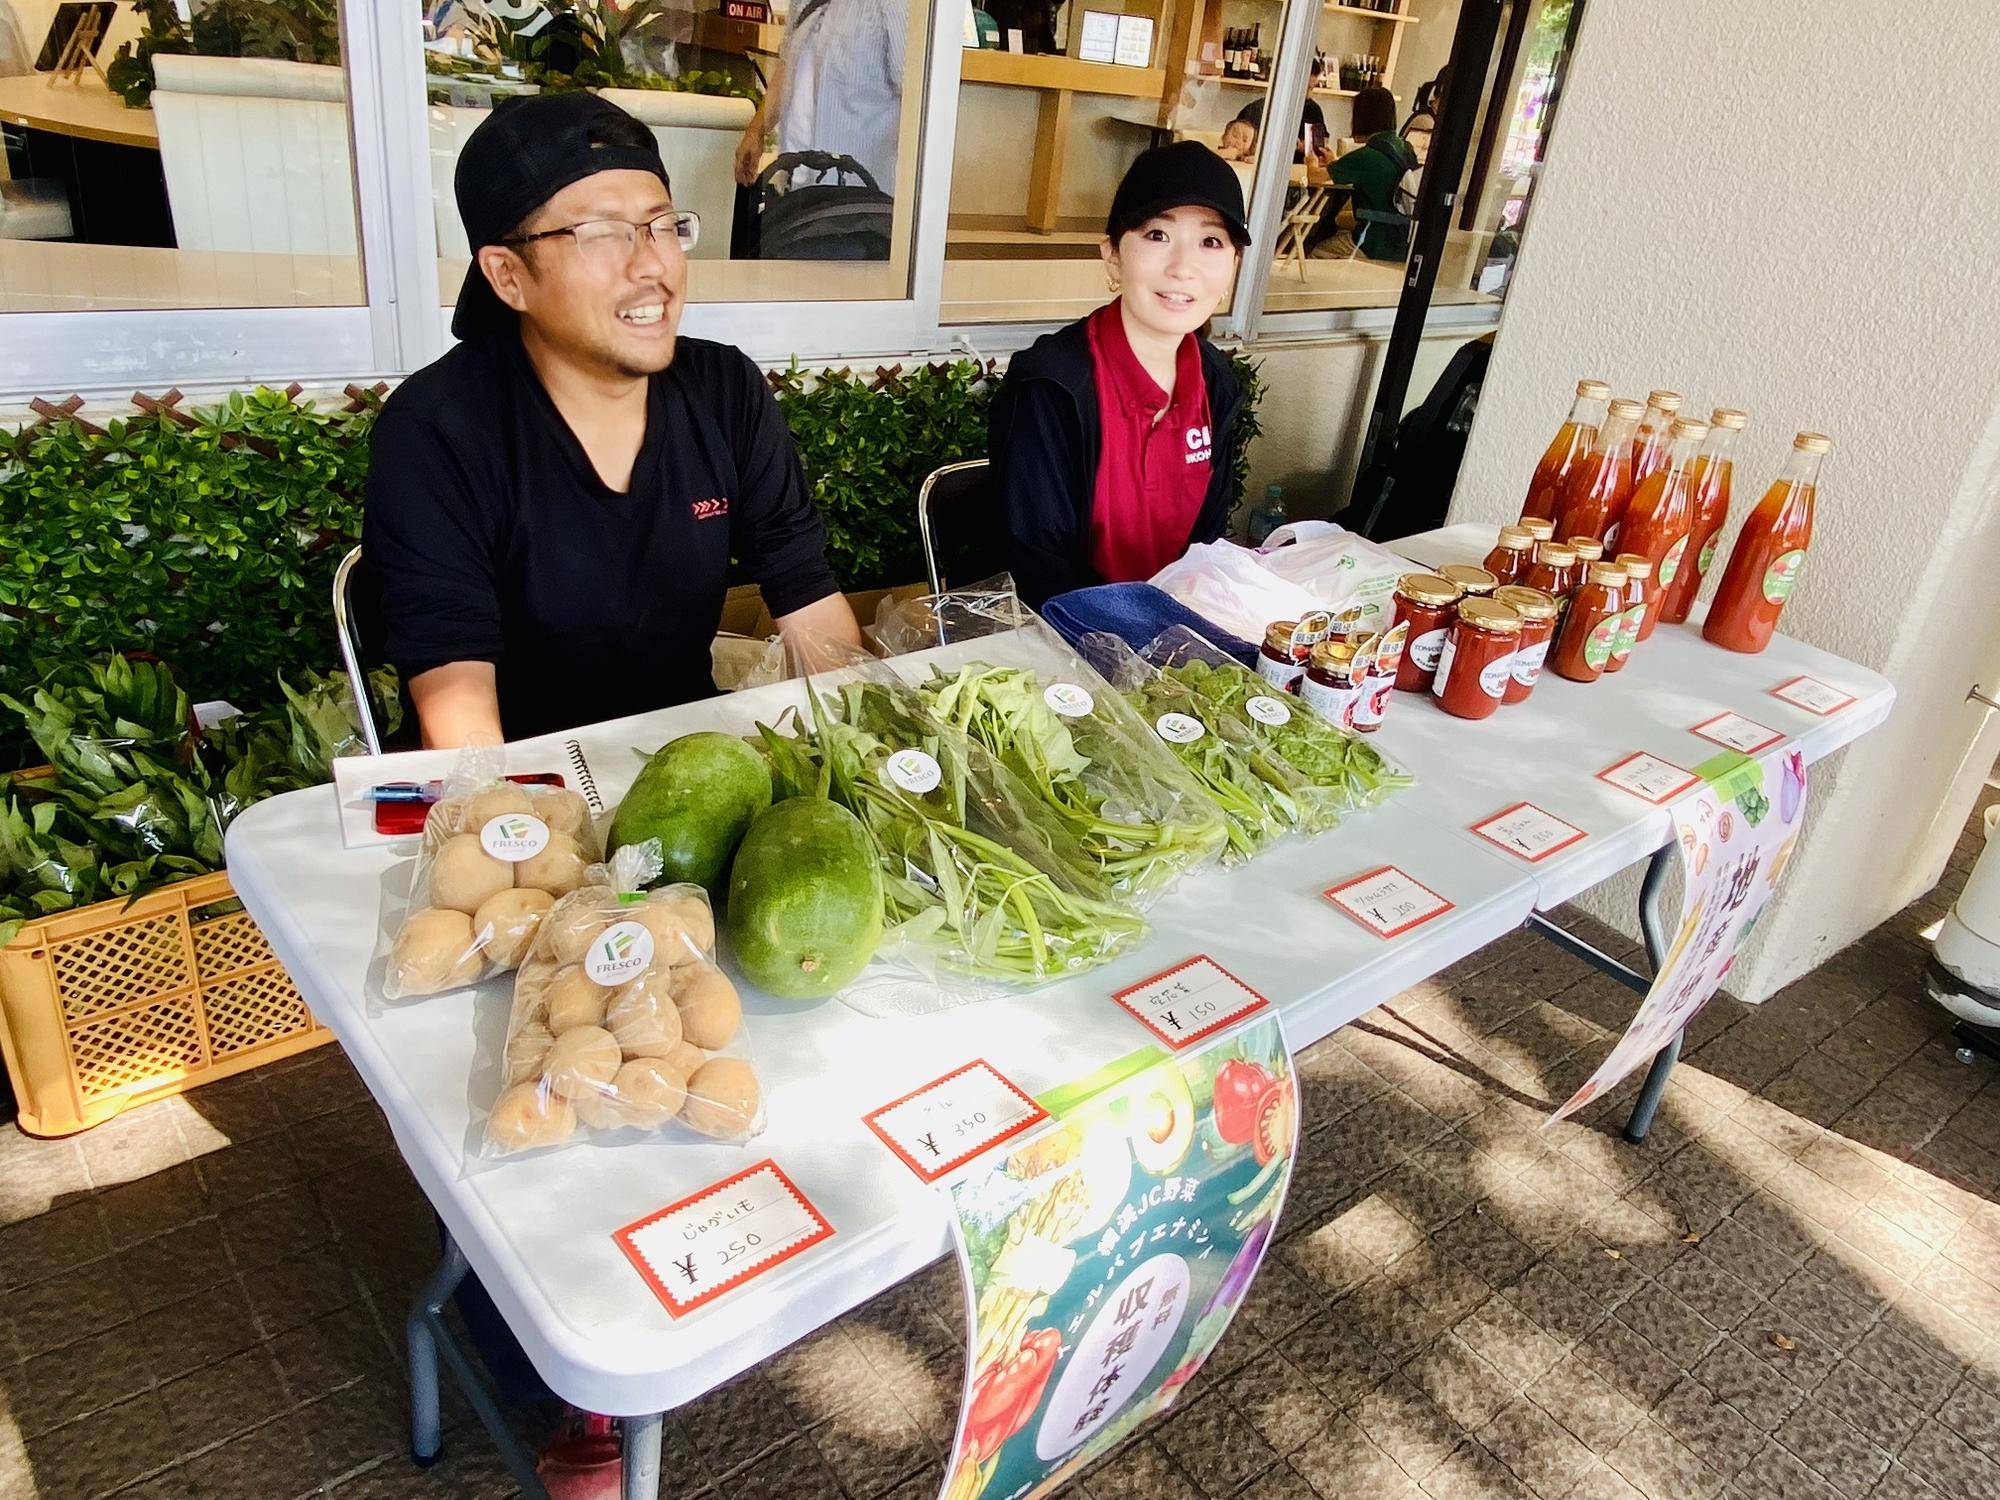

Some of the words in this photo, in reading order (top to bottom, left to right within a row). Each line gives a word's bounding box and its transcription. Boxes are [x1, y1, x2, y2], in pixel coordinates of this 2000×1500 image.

[728, 3, 744, 17] ON
[746, 6, 763, 19] AIR
[492, 839, 538, 848] FRESCO
[1368, 907, 1388, 924] ¥
[596, 956, 642, 974] FRESCO
[1160, 1010, 1184, 1031] ¥
[1188, 1001, 1217, 1021] 150
[916, 1131, 942, 1157] ¥
[952, 1111, 987, 1138] 350
[671, 1252, 699, 1286] ¥
[716, 1232, 763, 1266] 250
